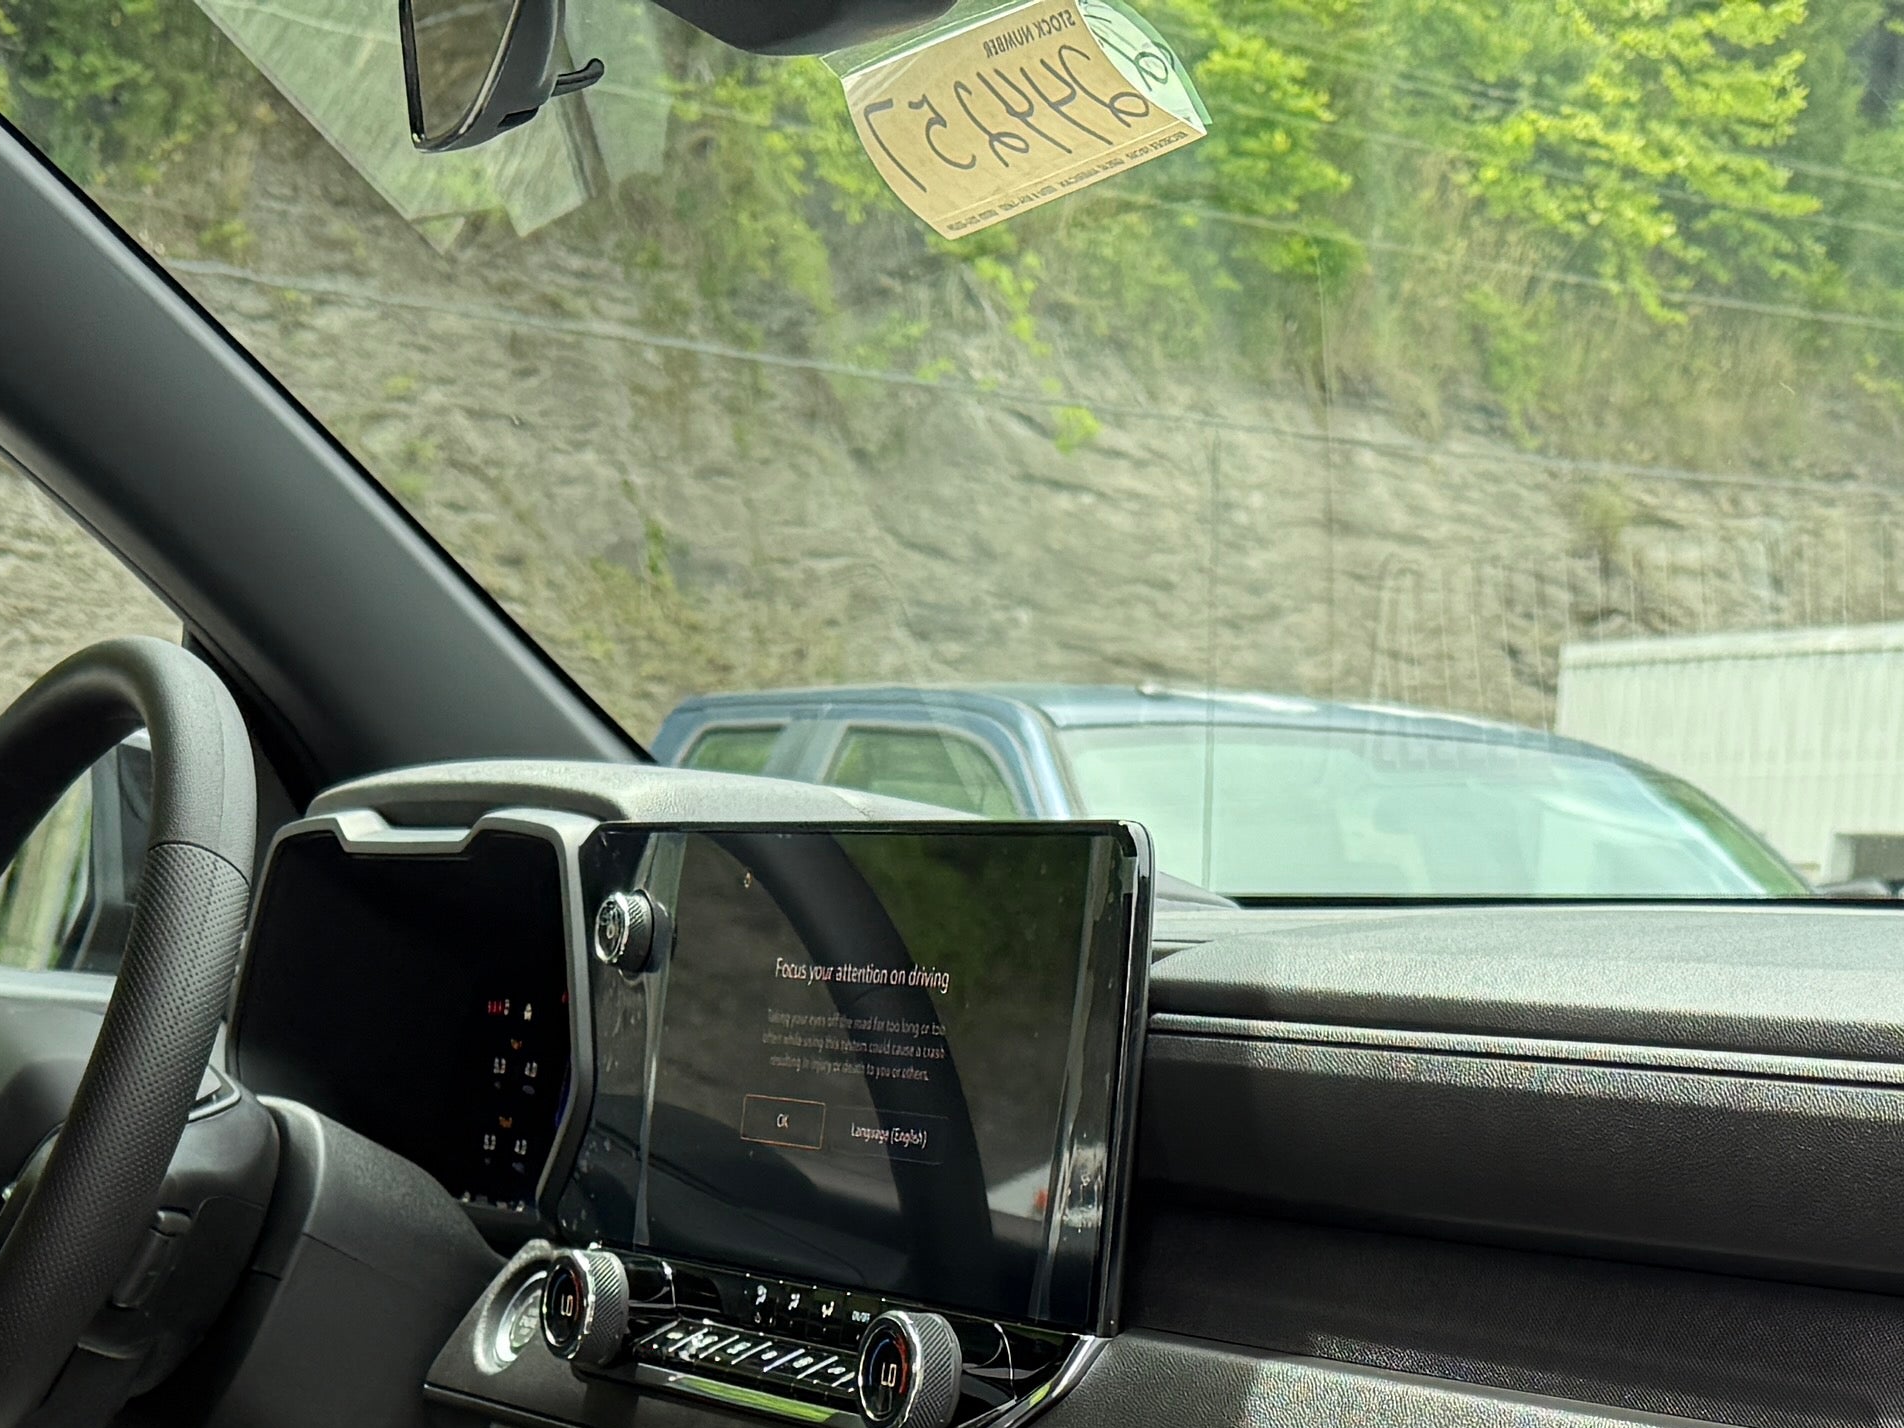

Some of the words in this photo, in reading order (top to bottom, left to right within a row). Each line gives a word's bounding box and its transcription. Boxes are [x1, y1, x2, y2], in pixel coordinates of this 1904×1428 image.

[775, 957, 807, 980] Focus
[808, 965, 834, 986] your
[835, 963, 887, 985] attention
[890, 969, 905, 985] on
[908, 963, 950, 994] driving
[872, 1016, 886, 1031] for
[886, 1019, 899, 1033] too
[901, 1018, 919, 1038] long
[920, 1024, 930, 1035] or
[932, 1022, 946, 1036] too
[868, 1038, 891, 1055] could
[892, 1044, 914, 1057] cause
[922, 1046, 945, 1059] crash
[875, 1066, 891, 1080] you
[776, 1113, 790, 1129] OK
[850, 1122, 889, 1145] Language
[890, 1128, 927, 1150] (English)
